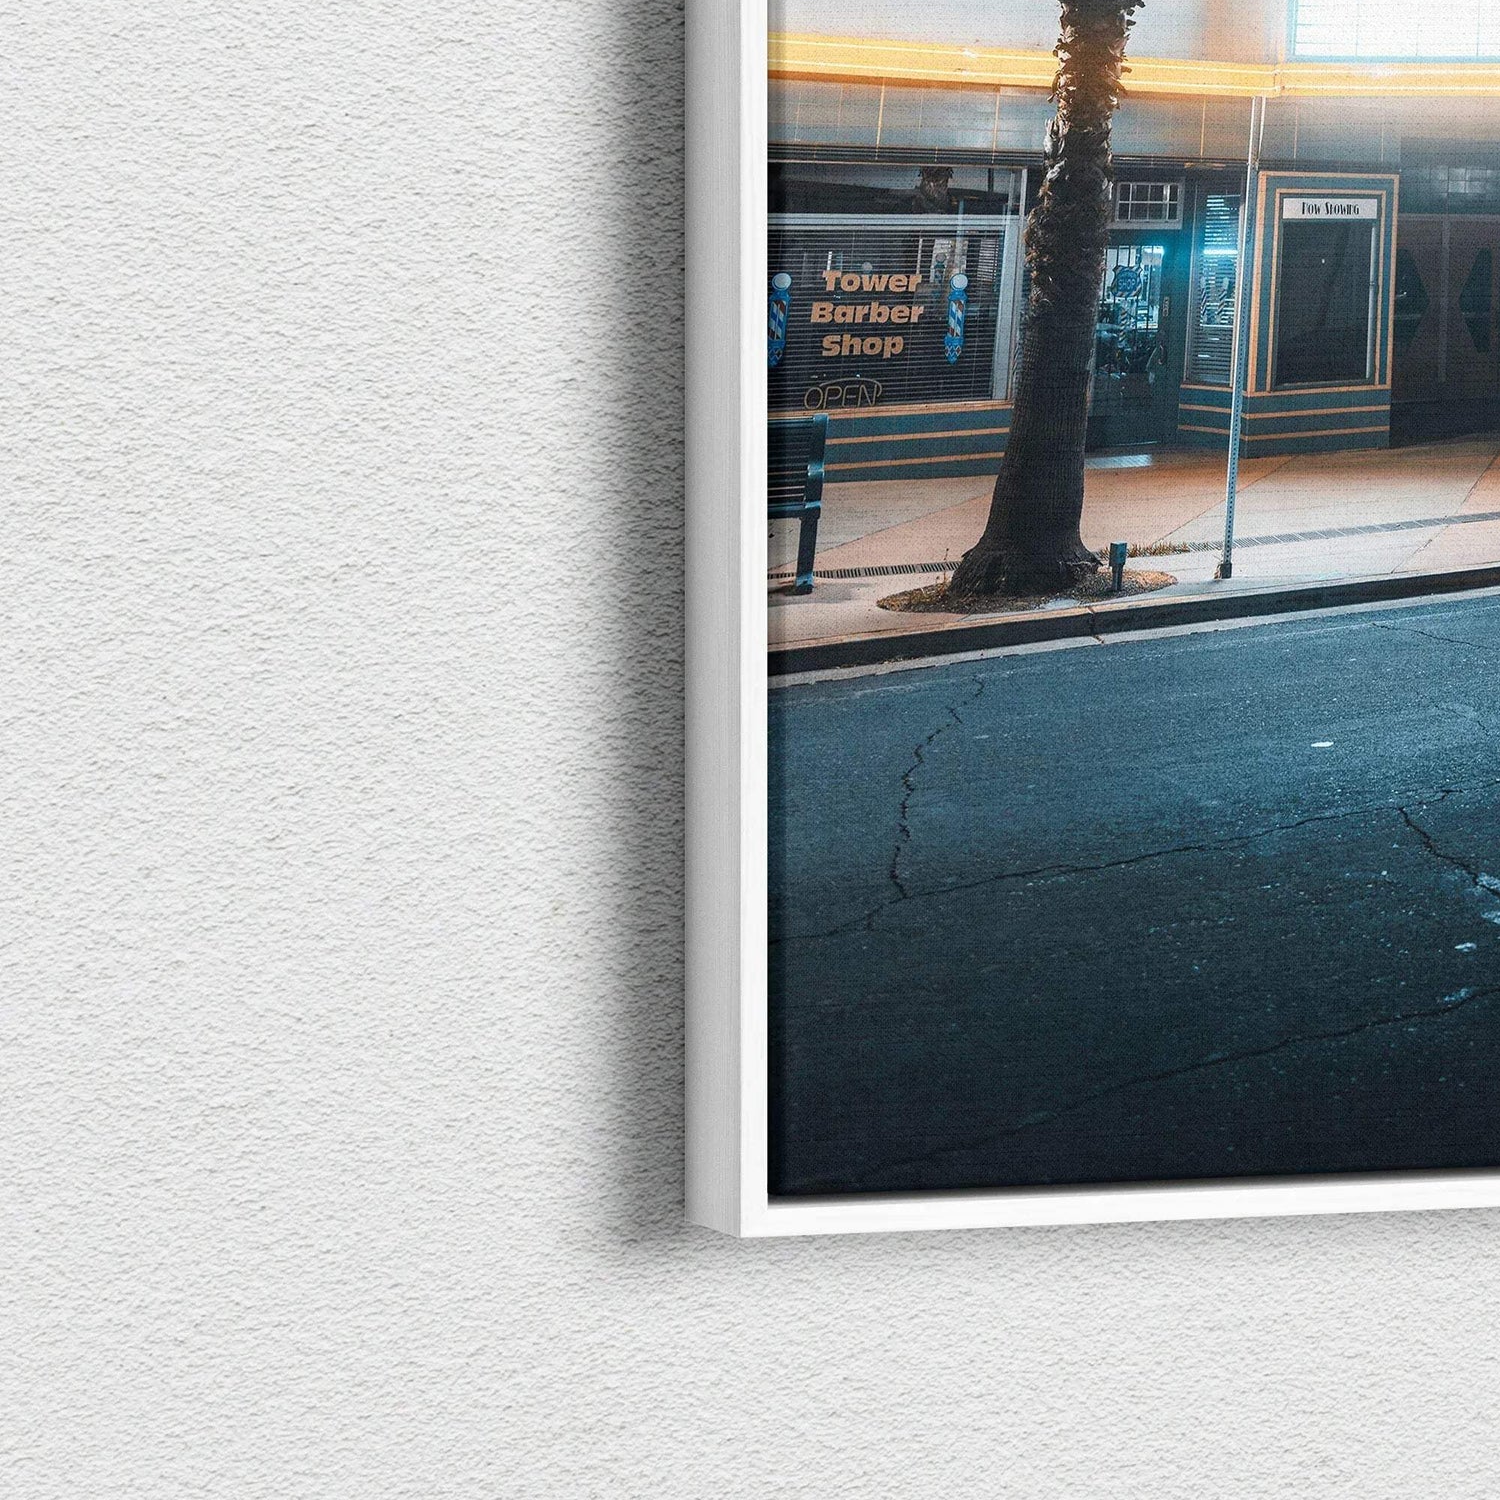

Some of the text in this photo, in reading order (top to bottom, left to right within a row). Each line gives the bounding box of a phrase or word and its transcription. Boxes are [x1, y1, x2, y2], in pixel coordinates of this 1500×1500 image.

[822, 270, 922, 292] Tower
[810, 301, 925, 323] Barber
[821, 334, 904, 359] Shop
[803, 384, 878, 410] OPEN
